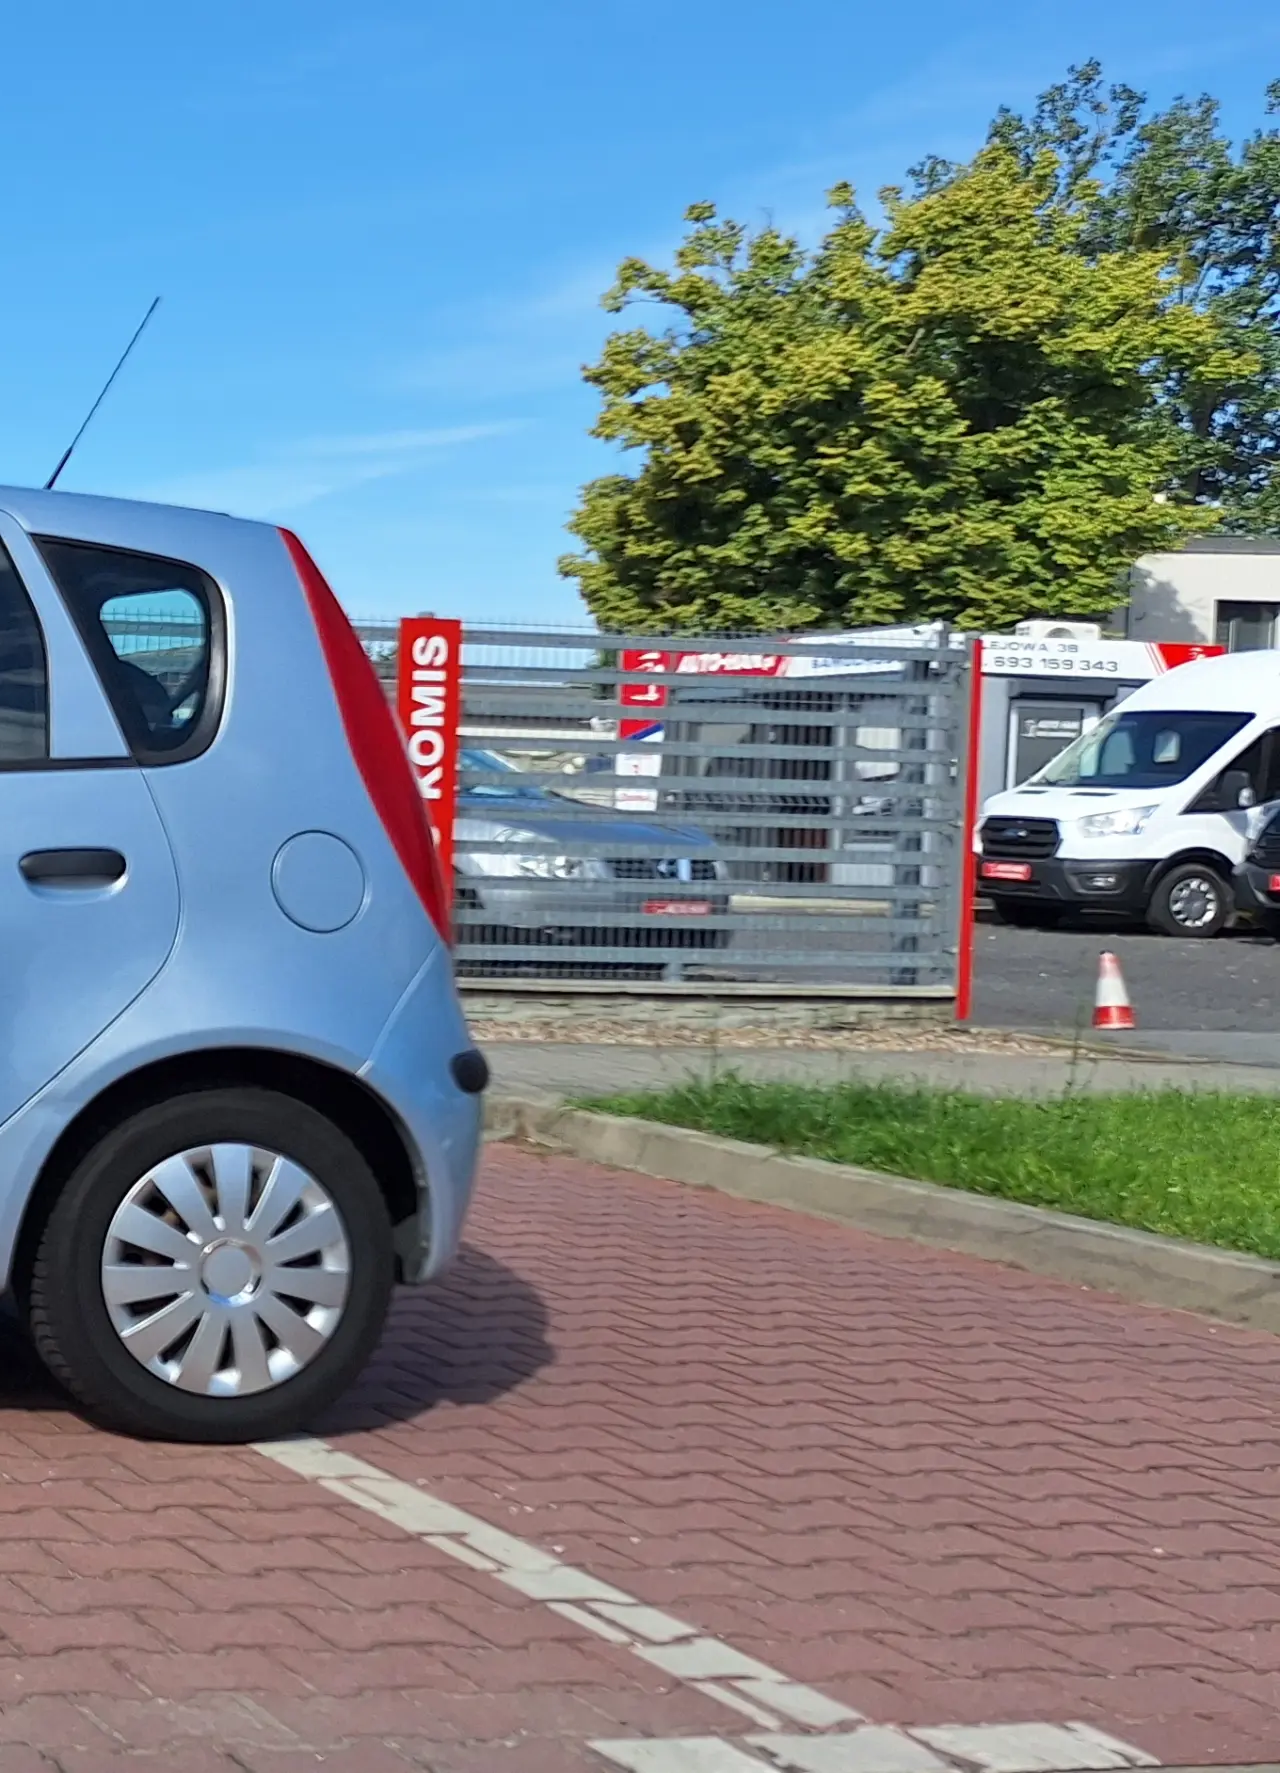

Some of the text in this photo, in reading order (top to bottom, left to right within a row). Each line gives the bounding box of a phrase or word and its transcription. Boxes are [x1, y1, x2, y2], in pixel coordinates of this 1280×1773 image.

[993, 656, 1119, 672] 693 159 343
[407, 635, 448, 800] KOMIS
